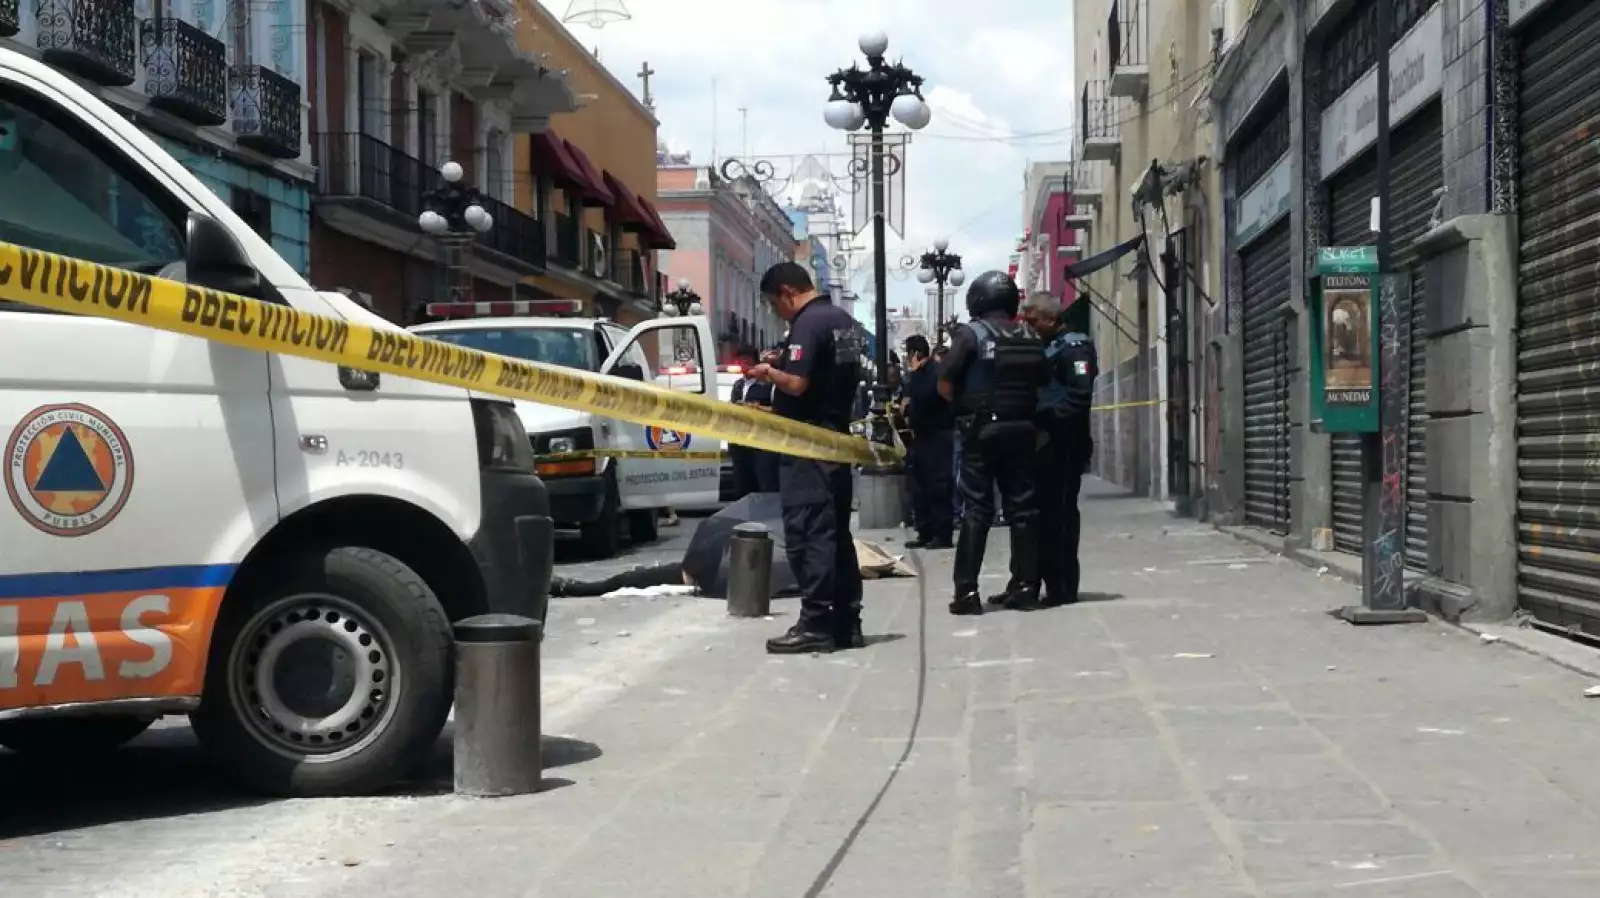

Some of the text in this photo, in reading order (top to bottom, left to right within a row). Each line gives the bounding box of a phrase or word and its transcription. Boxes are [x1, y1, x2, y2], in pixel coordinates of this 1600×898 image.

[58, 410, 84, 422] CIVIL
[336, 448, 404, 471] A-2043
[42, 512, 98, 528] PUEBLA
